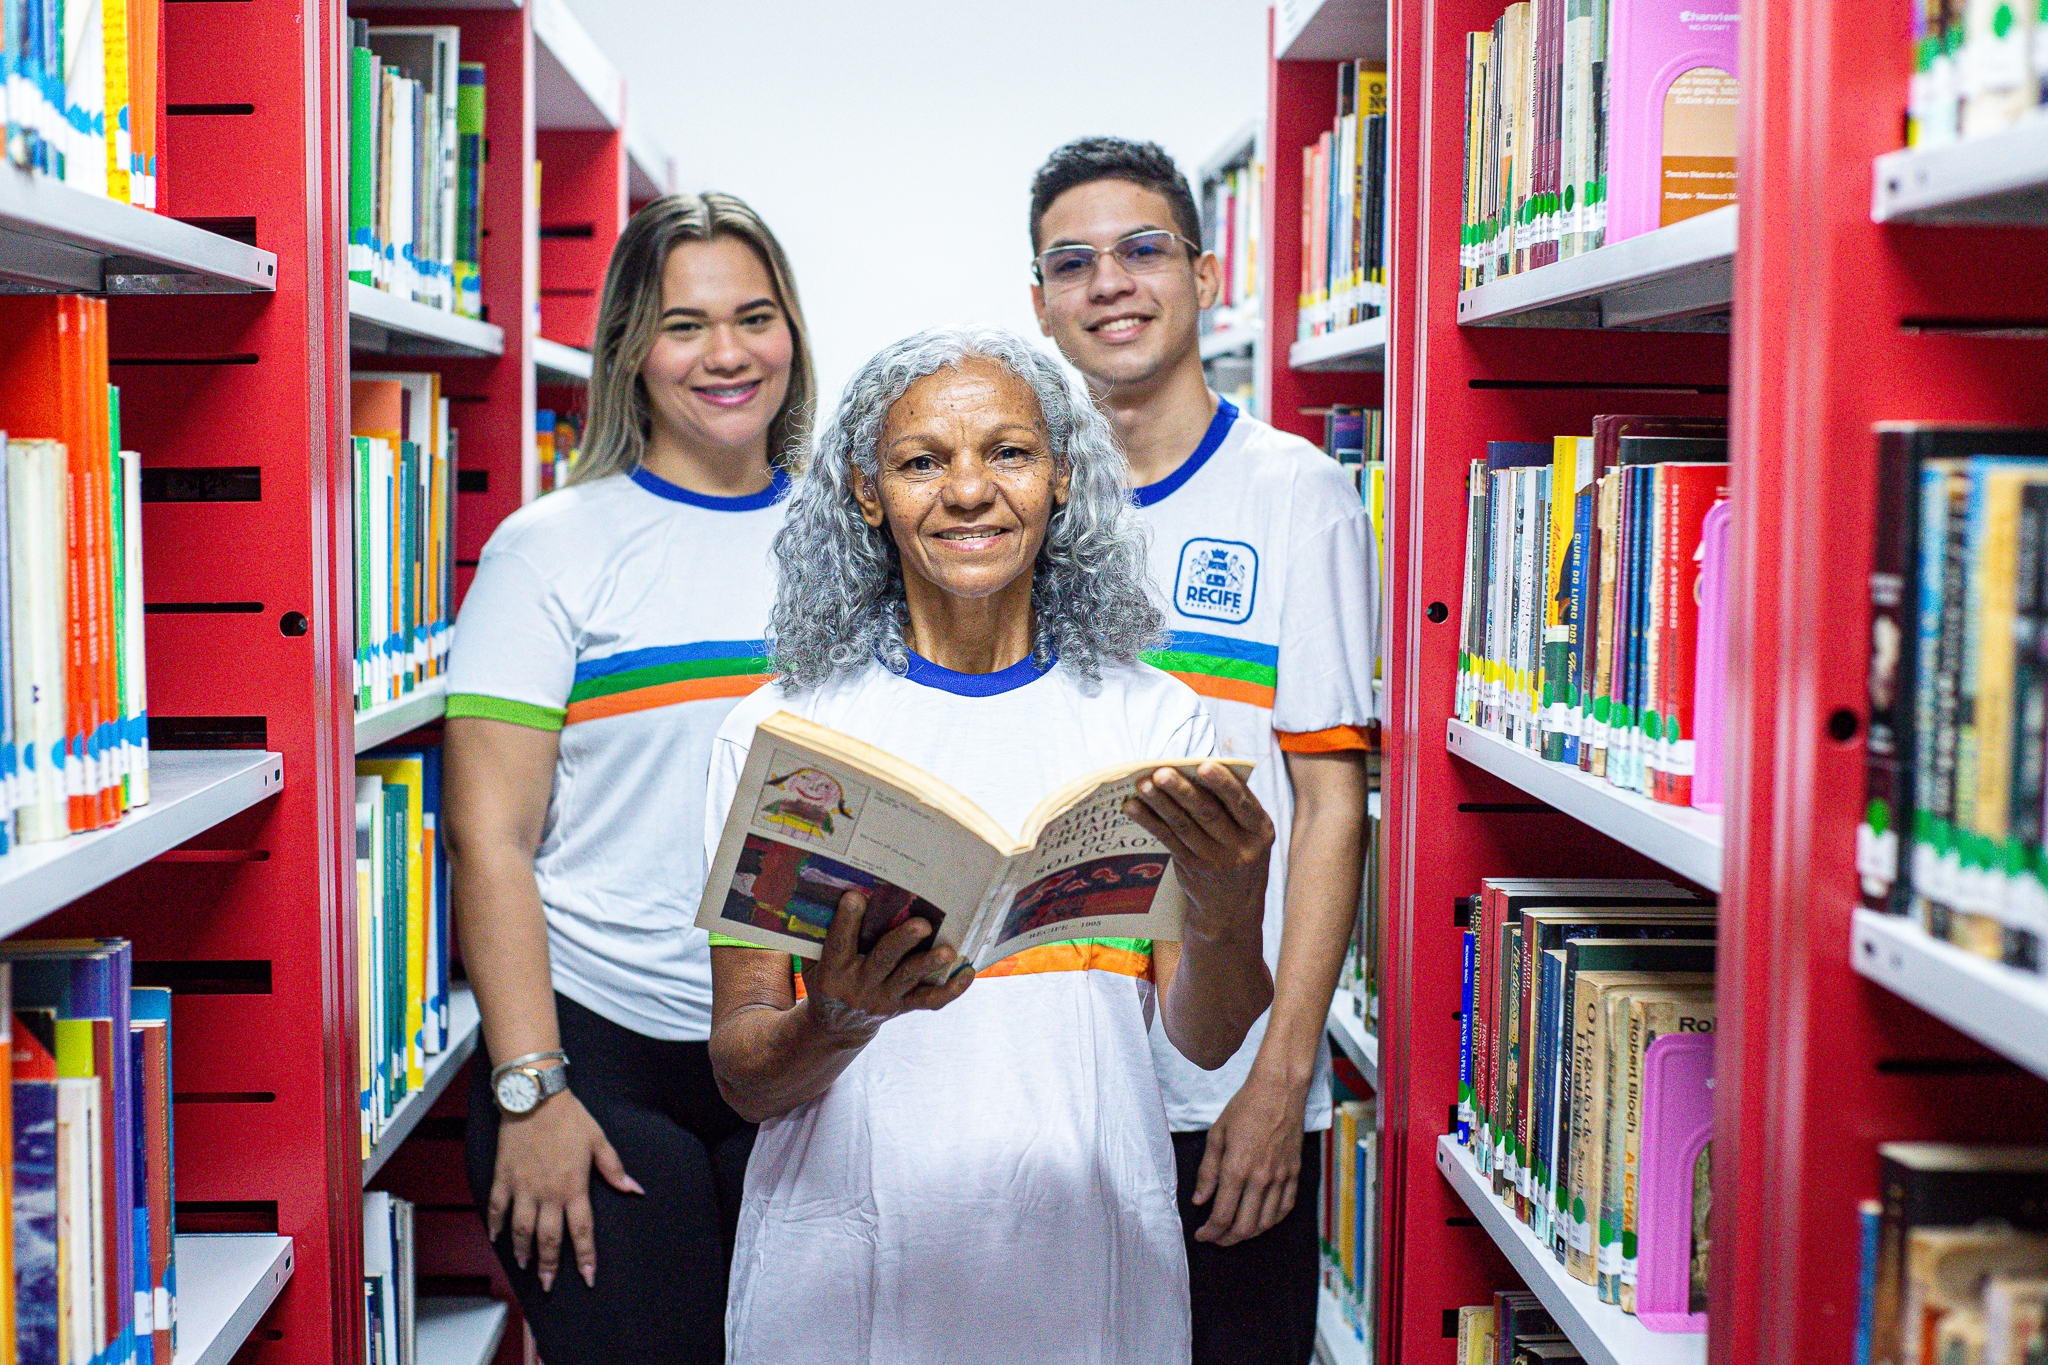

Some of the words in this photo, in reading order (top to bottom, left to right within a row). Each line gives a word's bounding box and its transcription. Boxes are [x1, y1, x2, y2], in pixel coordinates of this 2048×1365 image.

[1670, 484, 1680, 561] MARGARET
[1573, 533, 1581, 567] CLUBE
[1571, 569, 1579, 584] DO
[1187, 586, 1242, 608] RECIFE
[1570, 588, 1578, 619] LIVRO
[1669, 565, 1679, 629] ATWOOD
[1568, 623, 1577, 645] DOS
[1587, 1002, 1596, 1024] O
[1628, 1018, 1640, 1078] Robert
[1573, 1032, 1585, 1139] Humboldt
[1583, 1028, 1596, 1113] Legado
[1627, 1082, 1639, 1135] Bloch
[1583, 1118, 1593, 1144] de
[1625, 1151, 1634, 1165] A
